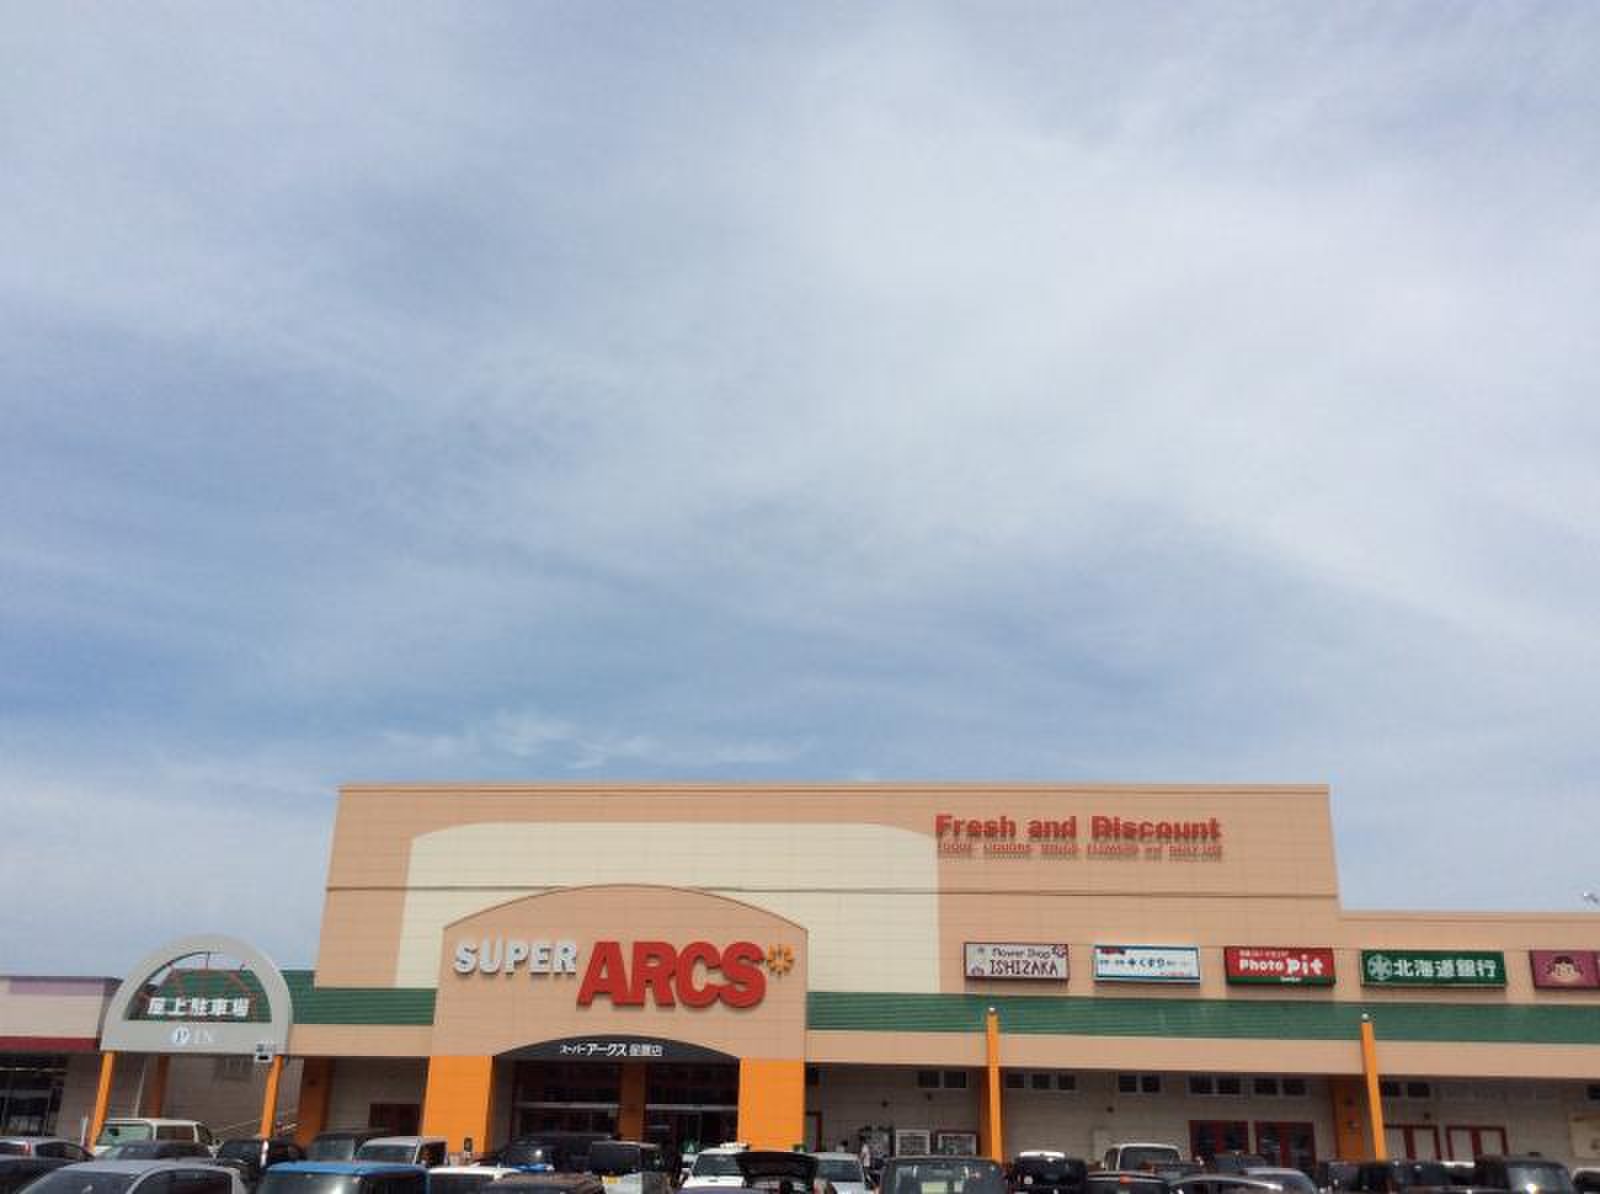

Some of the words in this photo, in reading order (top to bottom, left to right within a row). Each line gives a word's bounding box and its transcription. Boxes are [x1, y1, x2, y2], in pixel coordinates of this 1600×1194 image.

[935, 815, 1016, 839] Fresh
[1026, 815, 1077, 839] and
[1091, 816, 1221, 841] Discount
[454, 939, 577, 976] SUPER
[577, 941, 767, 1009] ARCS
[991, 959, 1058, 976] ISHIZAKA
[1239, 959, 1284, 971] Photo
[1286, 954, 1323, 975] pit
[1392, 959, 1497, 977] 北海道銀行
